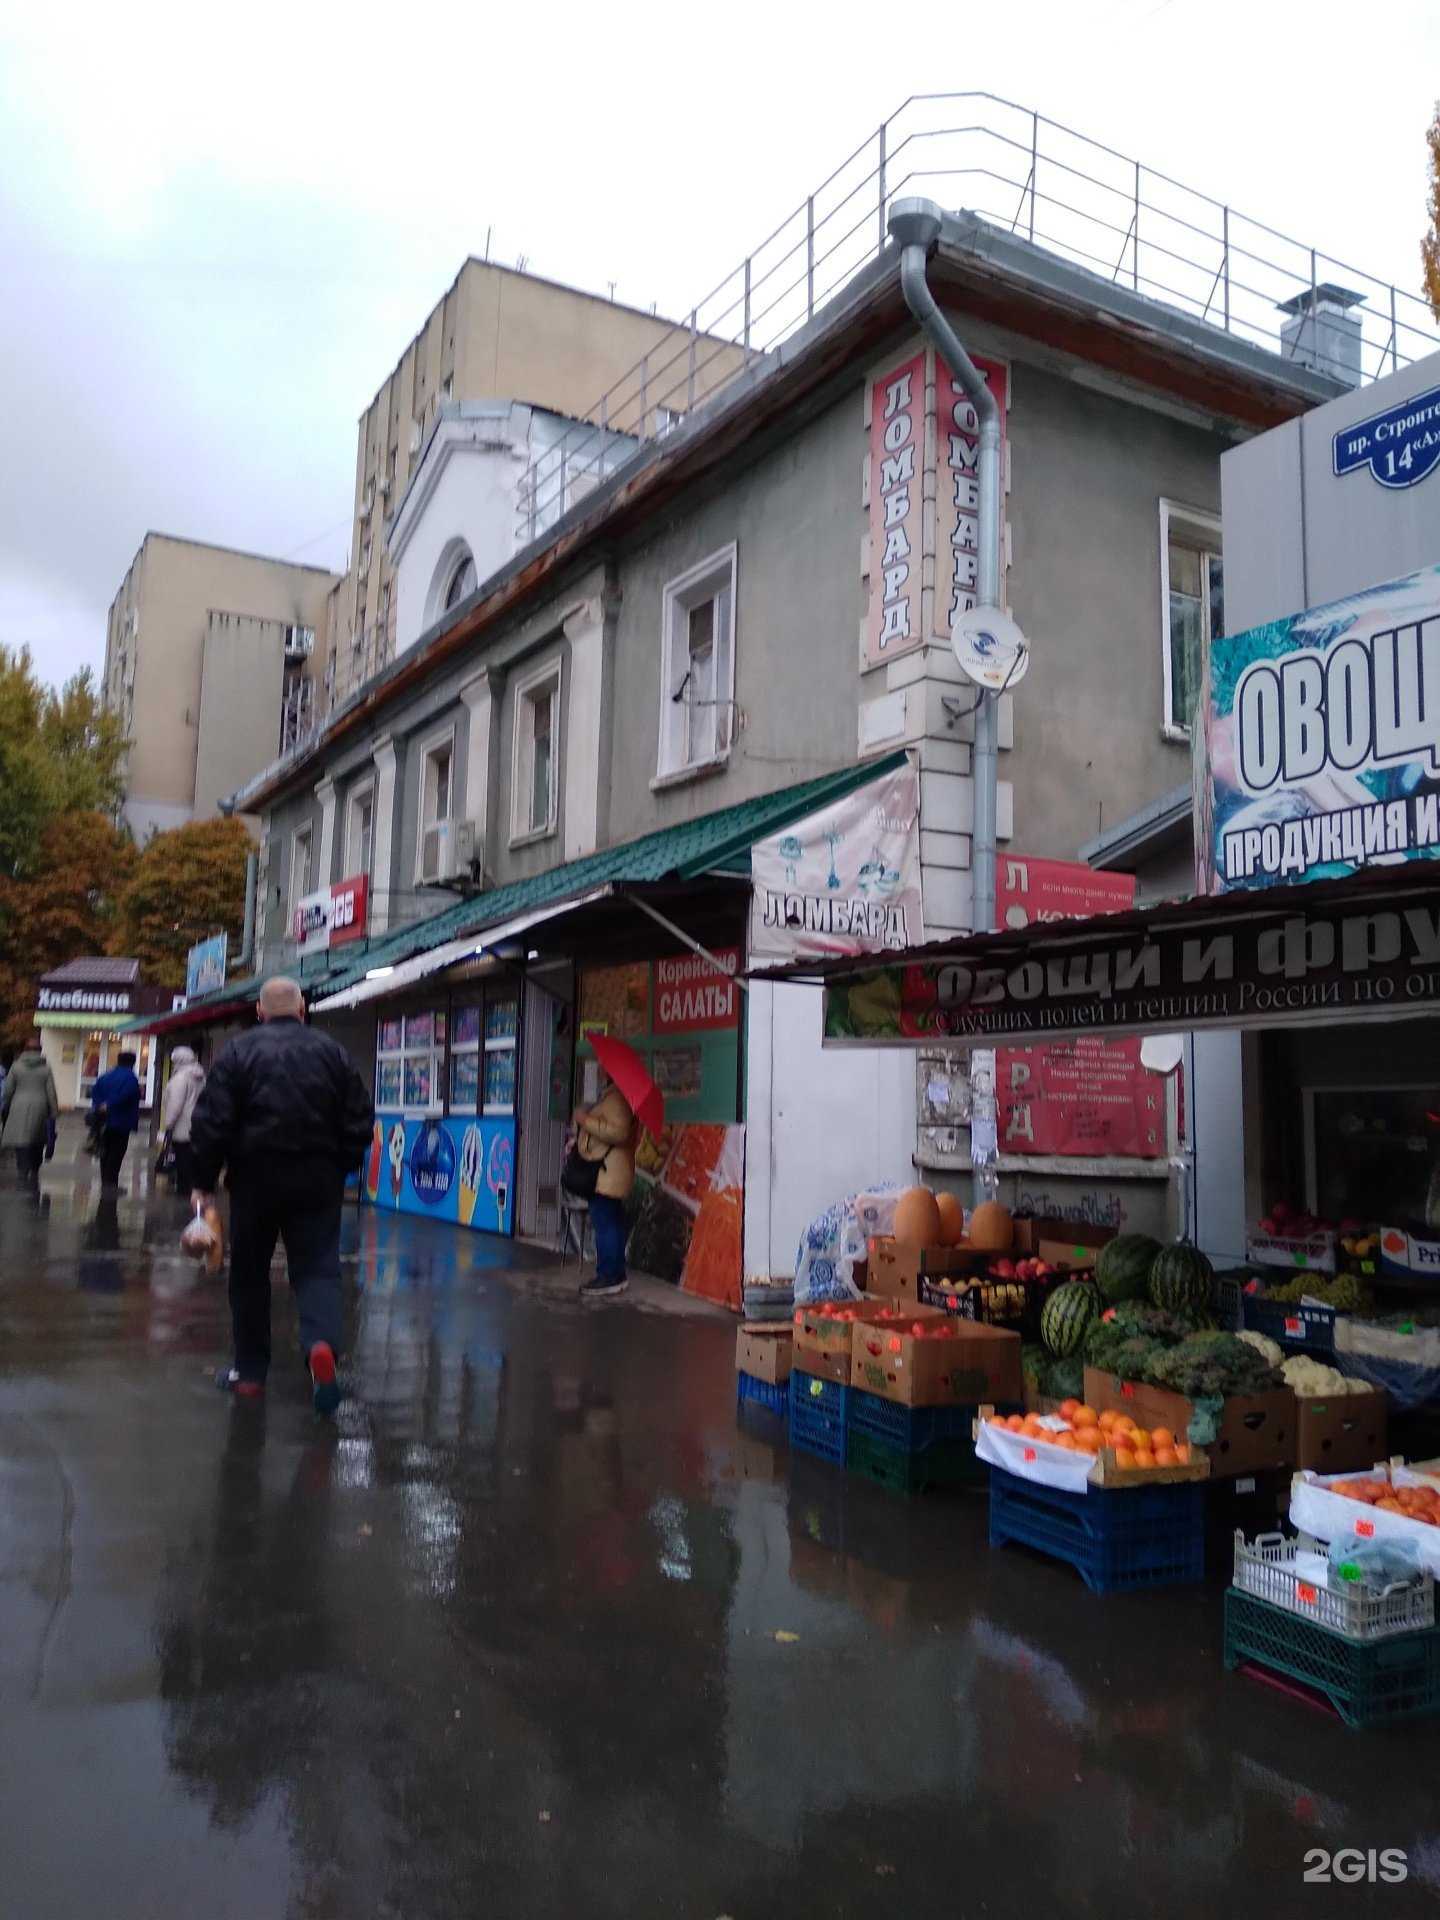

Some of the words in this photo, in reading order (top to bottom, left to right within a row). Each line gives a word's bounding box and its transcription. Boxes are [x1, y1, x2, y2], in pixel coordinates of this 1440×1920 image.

[1348, 436, 1371, 455] пр.
[1375, 402, 1440, 441] Строите
[880, 369, 916, 649] ЛОМБАРД
[1239, 615, 1440, 790] ОВОЩ
[1225, 800, 1407, 879] ПРОДУКЦИЯ
[1416, 794, 1440, 846] И
[763, 889, 910, 948] ЛОМБАРД
[38, 987, 130, 1012] Хлебница
[660, 983, 733, 1023] САЛАТЫ
[955, 1008, 1033, 1033] лучших
[1039, 999, 1104, 1026] полей
[1113, 1004, 1127, 1019] и
[1136, 990, 1230, 1017] теплиц
[1239, 980, 1341, 1010] России
[1354, 976, 1395, 1001] по
